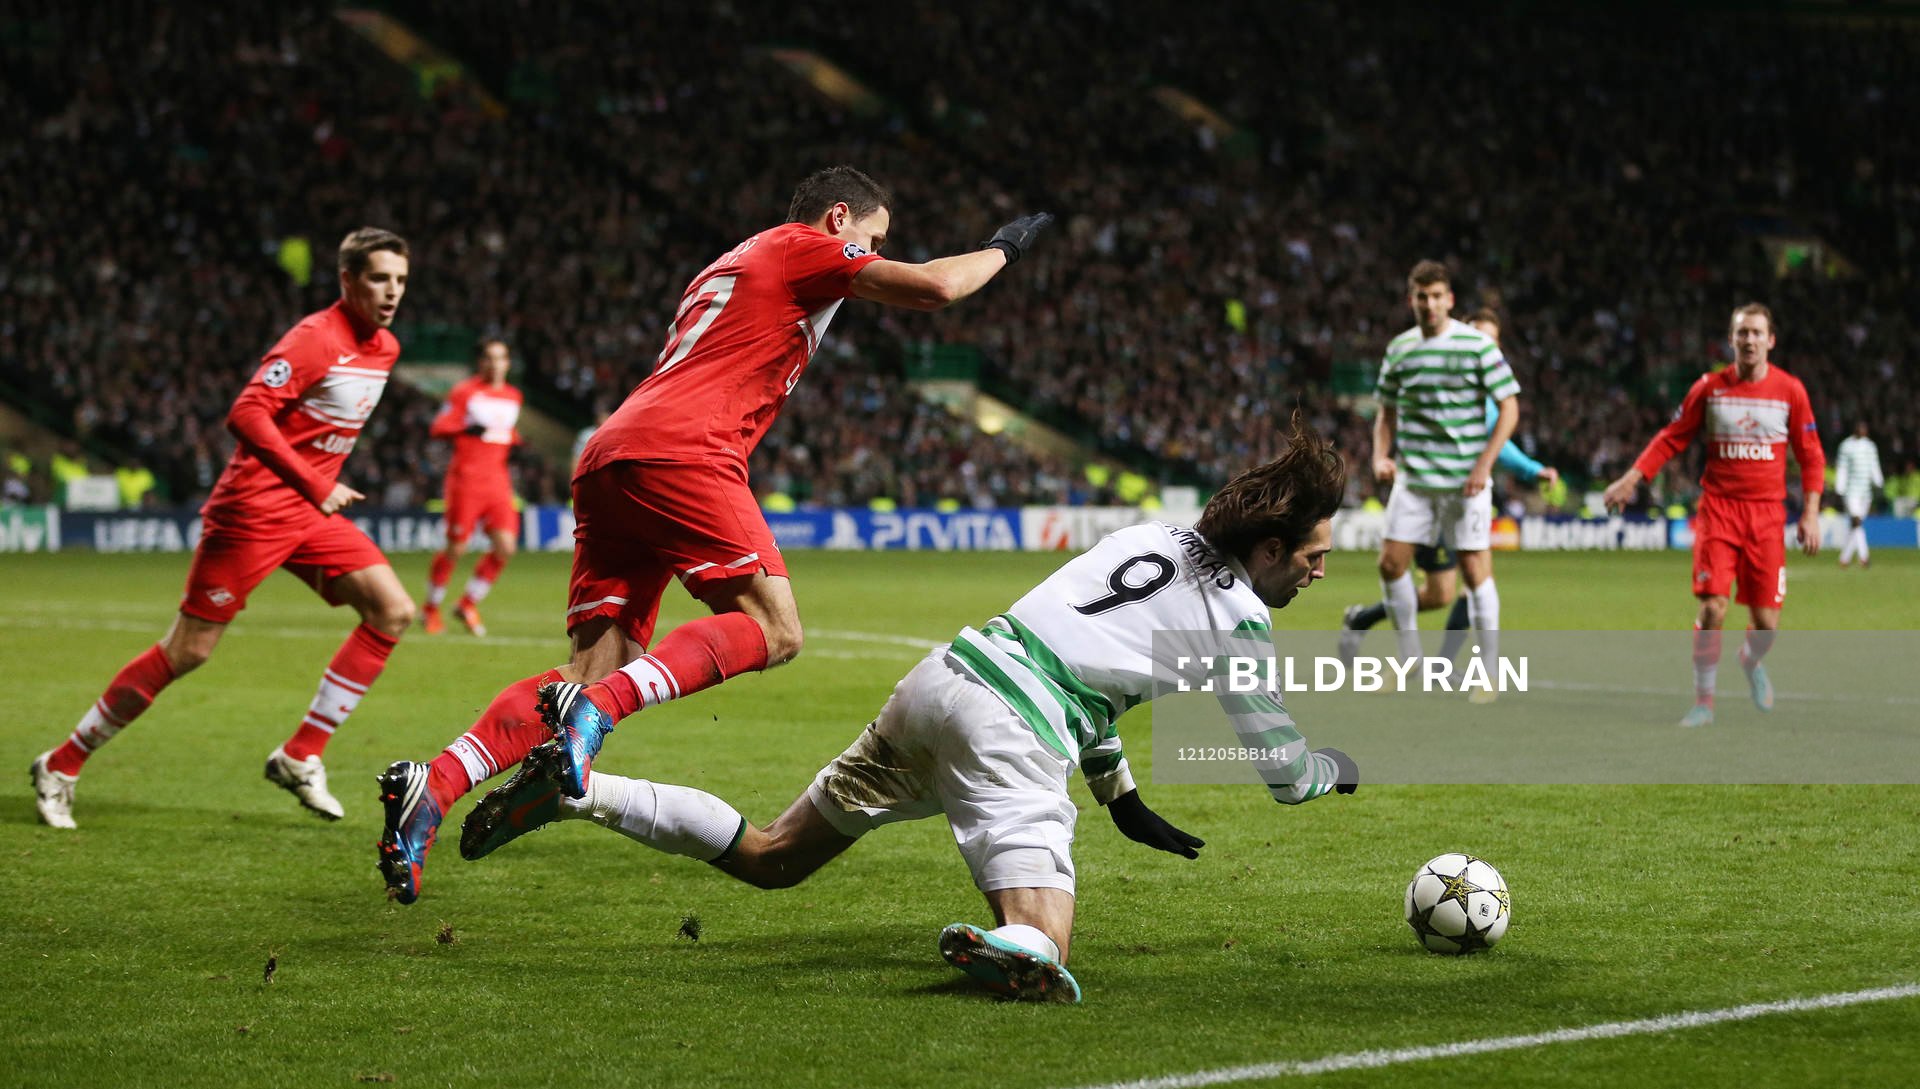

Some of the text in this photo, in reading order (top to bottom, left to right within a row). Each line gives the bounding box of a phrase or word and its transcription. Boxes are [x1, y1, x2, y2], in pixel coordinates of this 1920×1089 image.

[1720, 444, 1775, 461] LUKOIL
[93, 516, 184, 553] UEFA
[1522, 513, 1668, 550] MasterCard
[1068, 551, 1179, 617] 9
